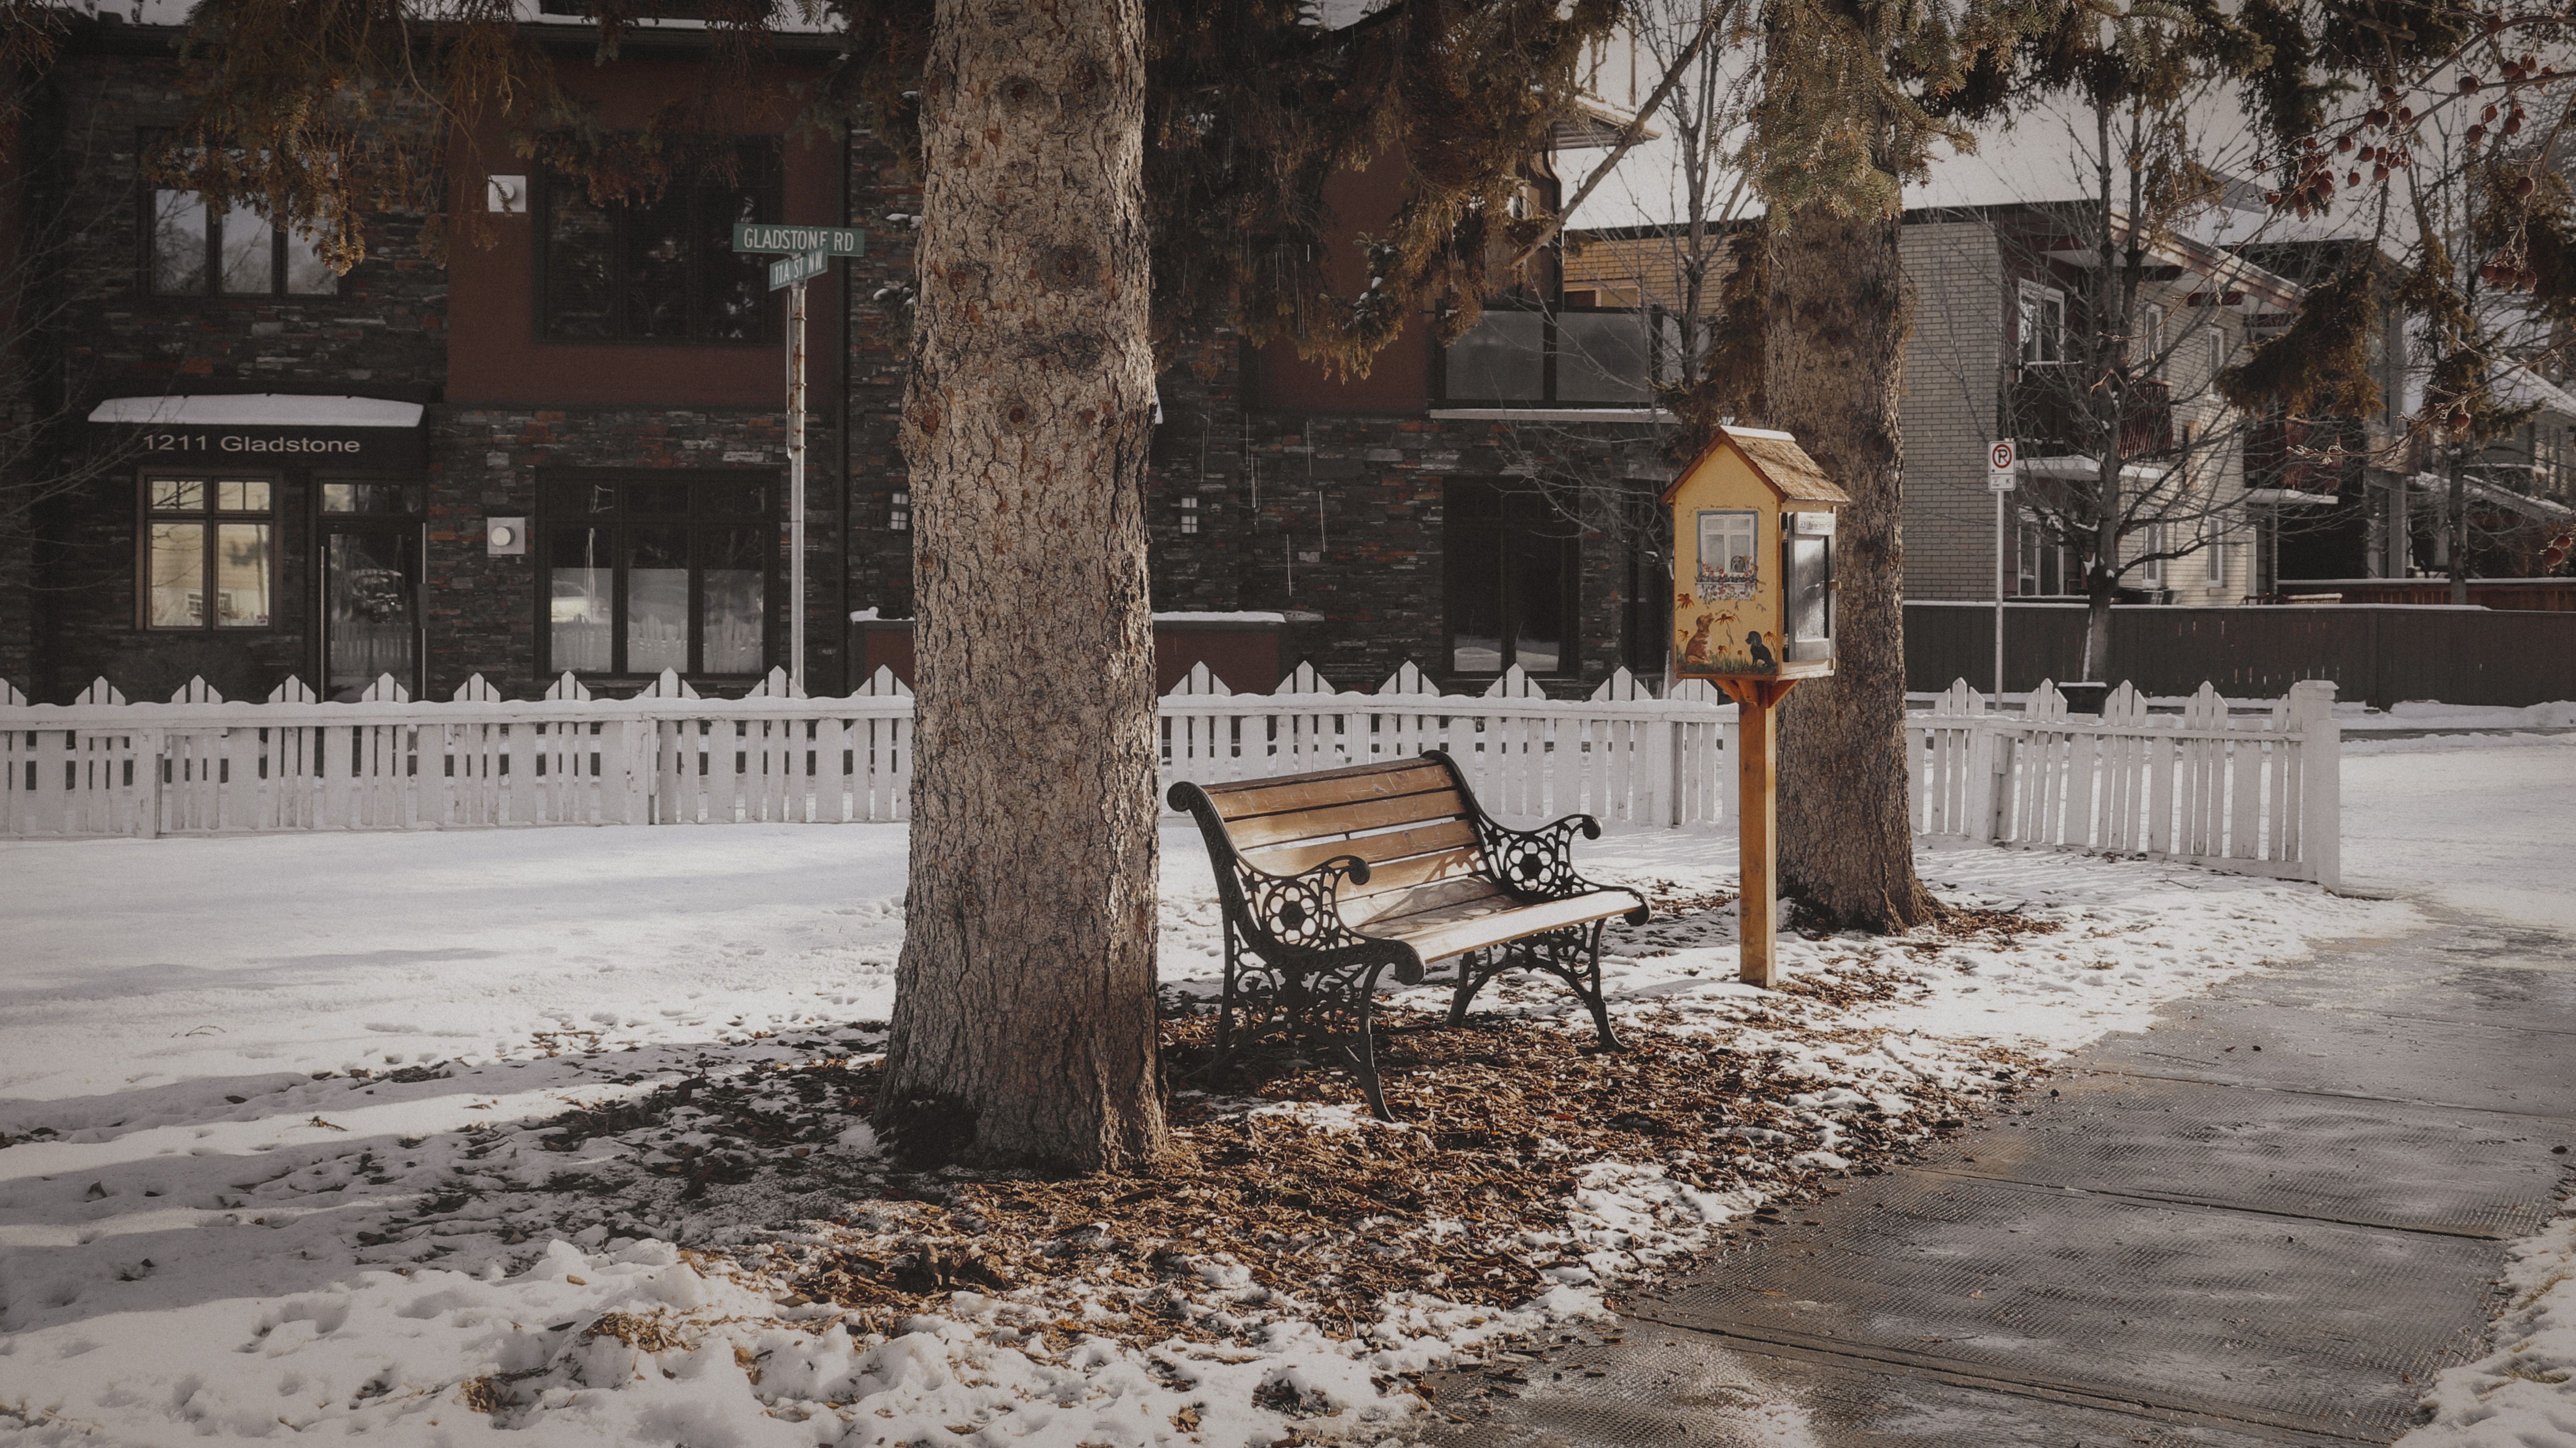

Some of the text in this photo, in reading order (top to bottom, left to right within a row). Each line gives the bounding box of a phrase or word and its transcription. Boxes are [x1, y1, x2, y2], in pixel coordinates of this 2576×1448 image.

[743, 228, 854, 252] GLADSTONE RD
[774, 250, 823, 285] 11A ST NW
[143, 434, 361, 453] 1211 Gladstone
